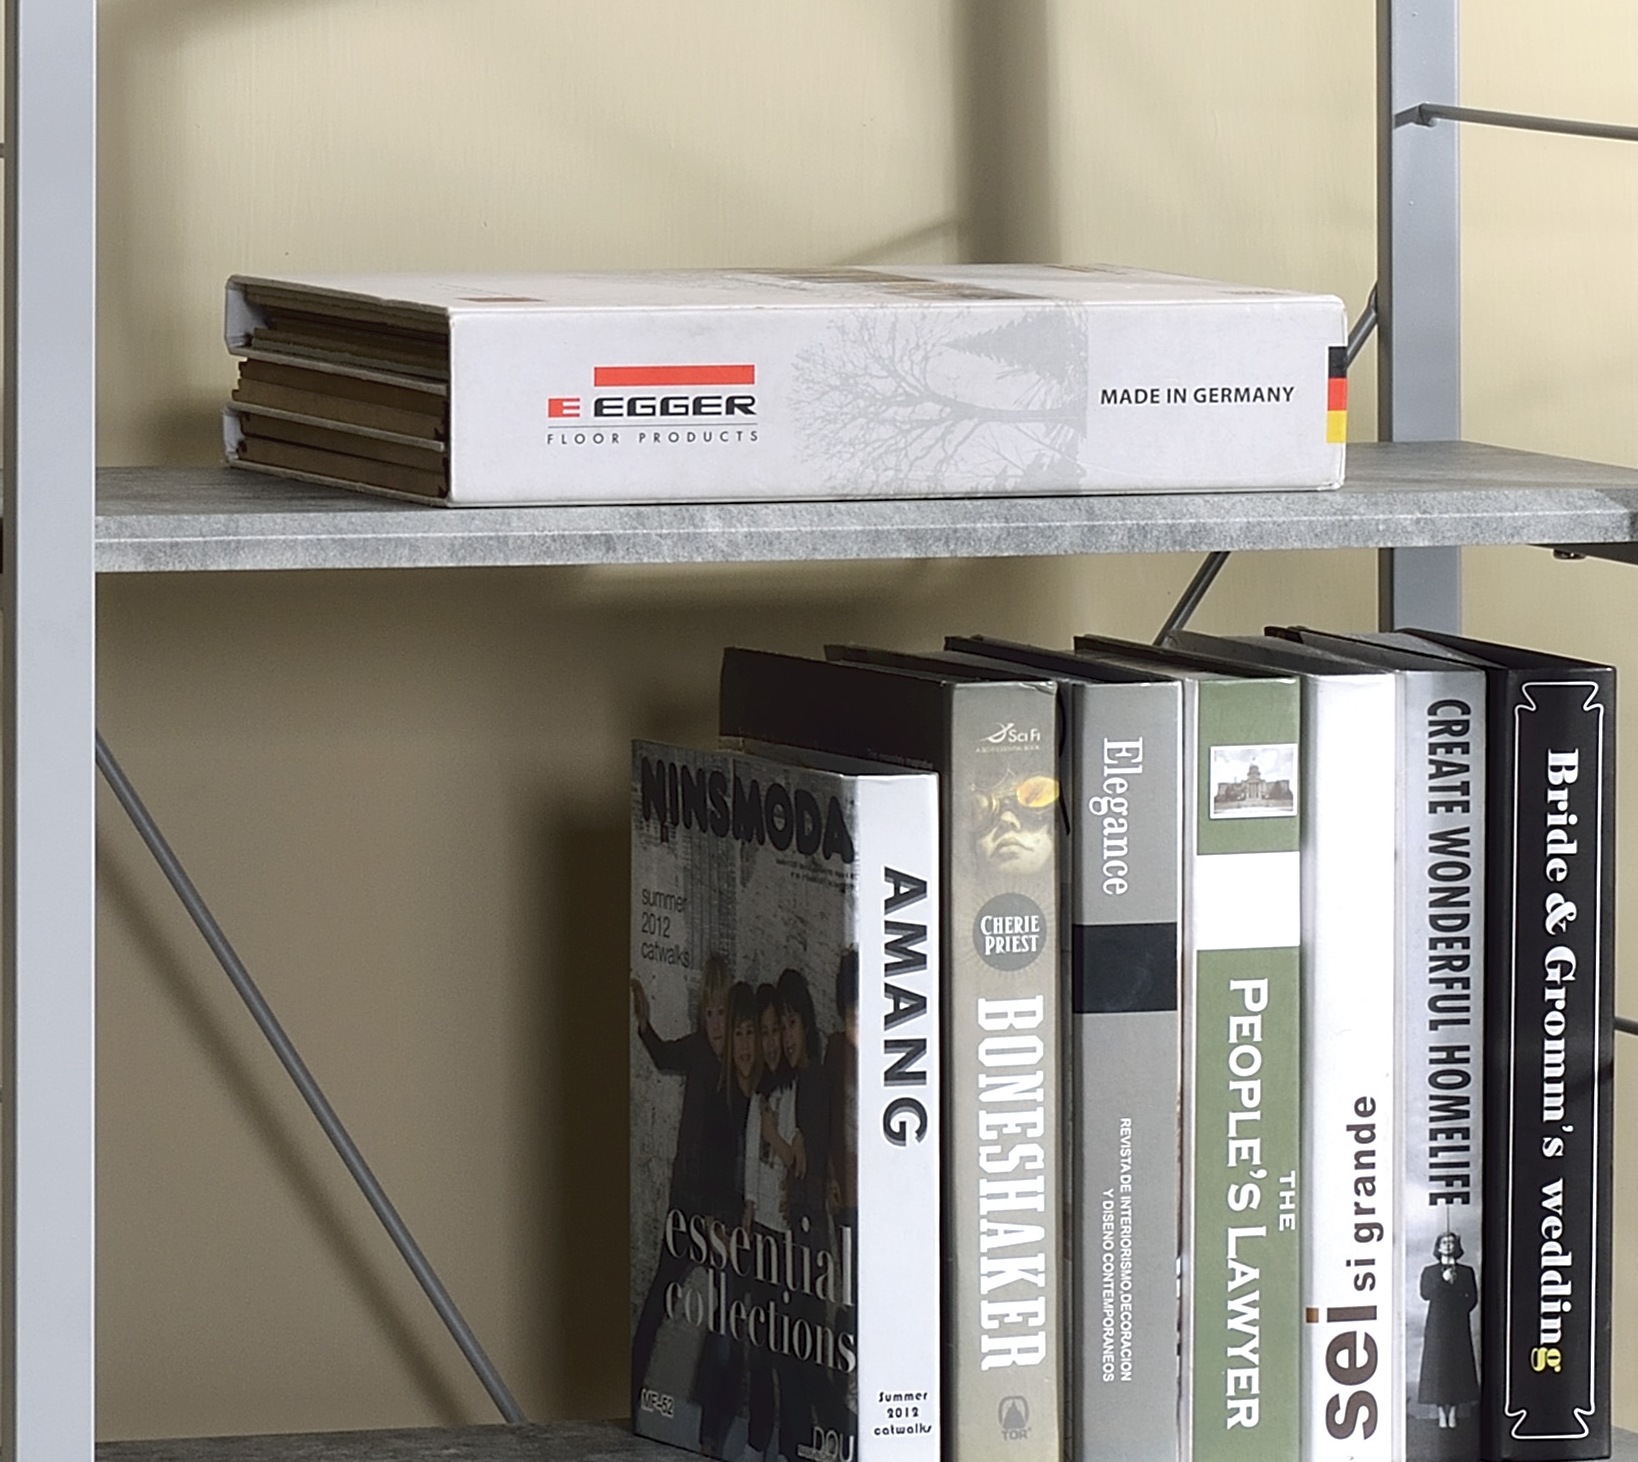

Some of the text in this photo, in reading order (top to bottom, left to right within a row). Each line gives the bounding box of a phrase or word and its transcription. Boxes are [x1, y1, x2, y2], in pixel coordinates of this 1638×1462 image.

[593, 395, 757, 418] EGGER
[1100, 386, 1296, 405] MADE IN GERMANY
[546, 430, 759, 445] FLOOR PRODUCTS
[1088, 736, 1144, 896] Elegance
[641, 888, 688, 913] summer
[640, 912, 671, 939] 2012
[980, 914, 1041, 936] CHERIE
[640, 940, 690, 969] catwalks
[984, 934, 1040, 956] PRIEST
[1427, 698, 1472, 1207] CREATE WONDERFUL HOMELIFE
[882, 865, 928, 1148] AMANG
[1530, 747, 1579, 1375] Bride & Gromm's wedding
[977, 994, 1047, 1371] BONESHAKER
[1345, 1095, 1385, 1244] grande
[1101, 1188, 1115, 1198] Y
[1224, 977, 1269, 1431] PEOPLE'S LAWYER
[1277, 1170, 1297, 1232] THE
[665, 1207, 856, 1307] essential
[1345, 1258, 1377, 1292] si
[665, 1267, 857, 1374] collections
[1101, 1252, 1115, 1382] CONTEMPORANEOS
[877, 1390, 929, 1403] Summer
[886, 1407, 920, 1419] 2012
[873, 1422, 933, 1437] catwalks
